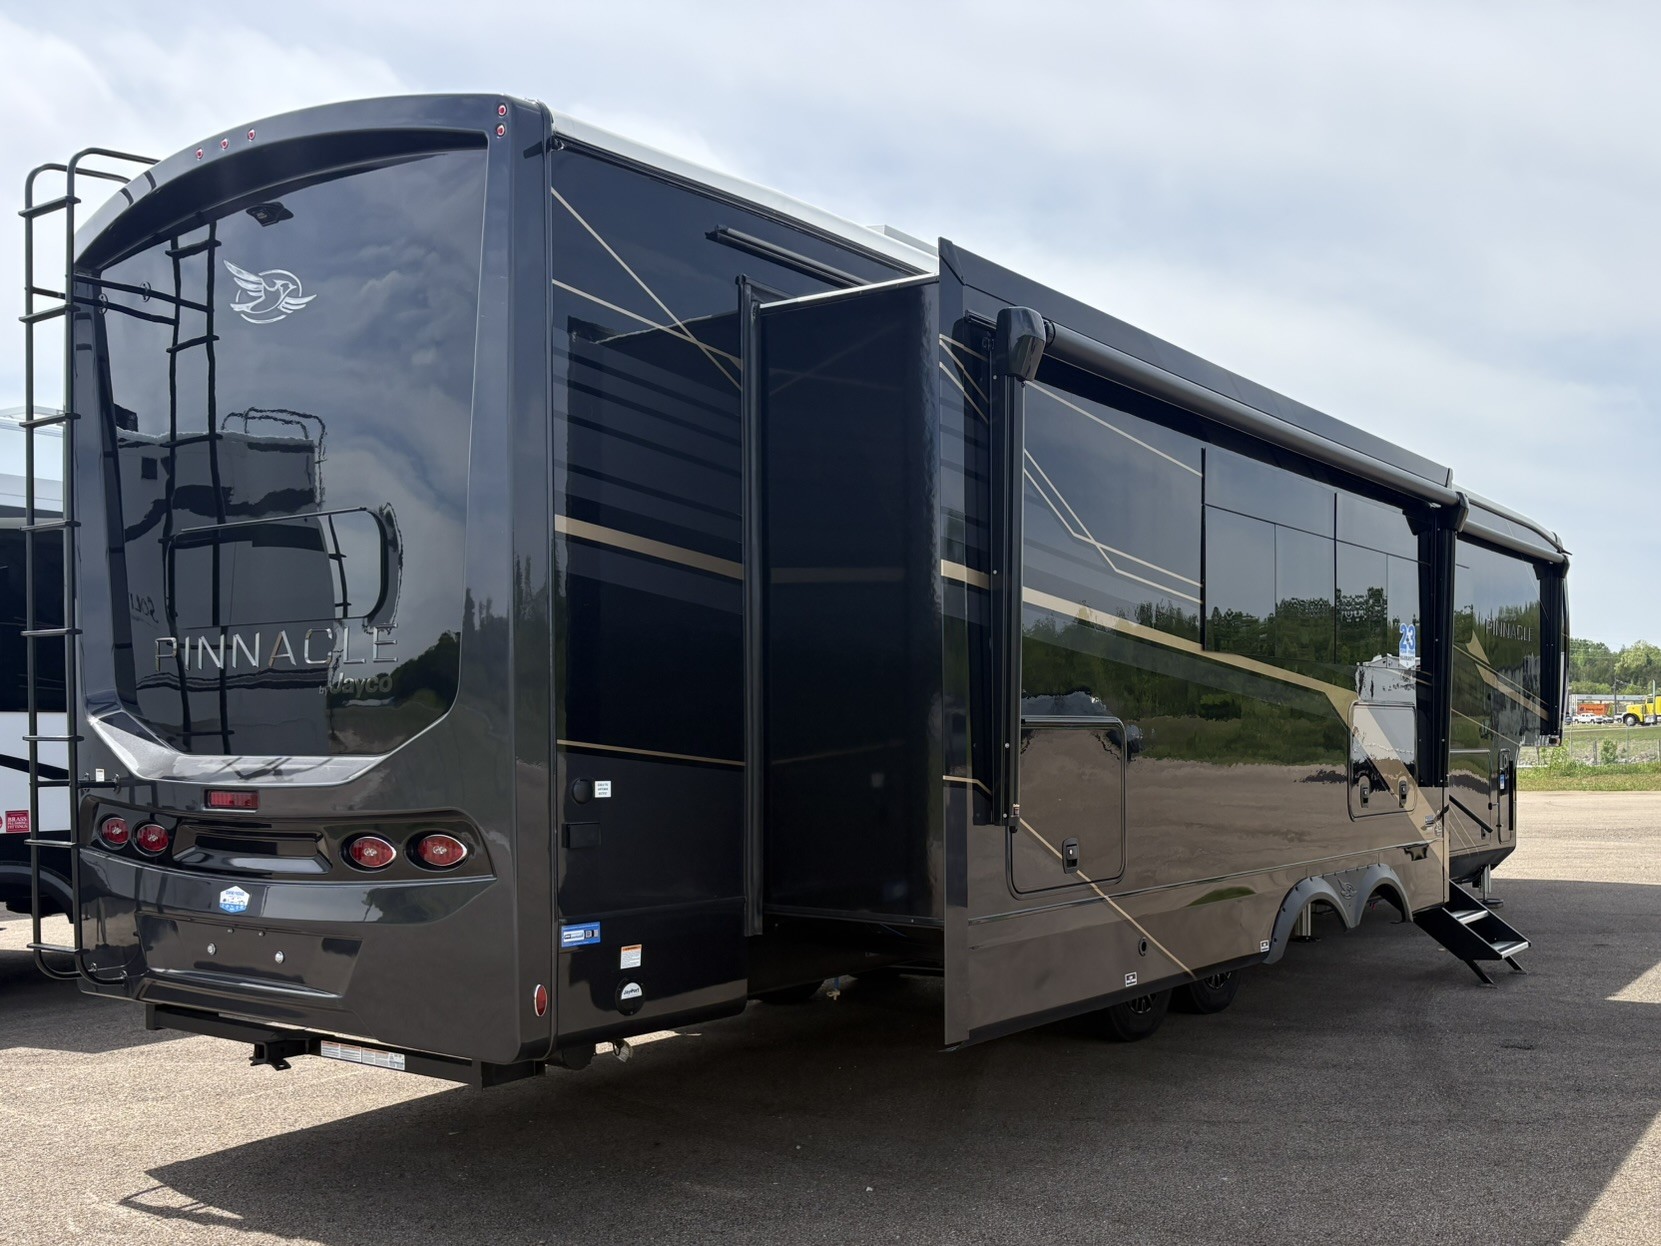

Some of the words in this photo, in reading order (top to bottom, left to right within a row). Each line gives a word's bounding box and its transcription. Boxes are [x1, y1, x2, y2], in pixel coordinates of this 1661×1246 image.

[1486, 618, 1534, 642] PINNACLE
[154, 622, 399, 672] PINNACLE
[330, 672, 393, 699] Jayco
[623, 987, 640, 996] JayPort
